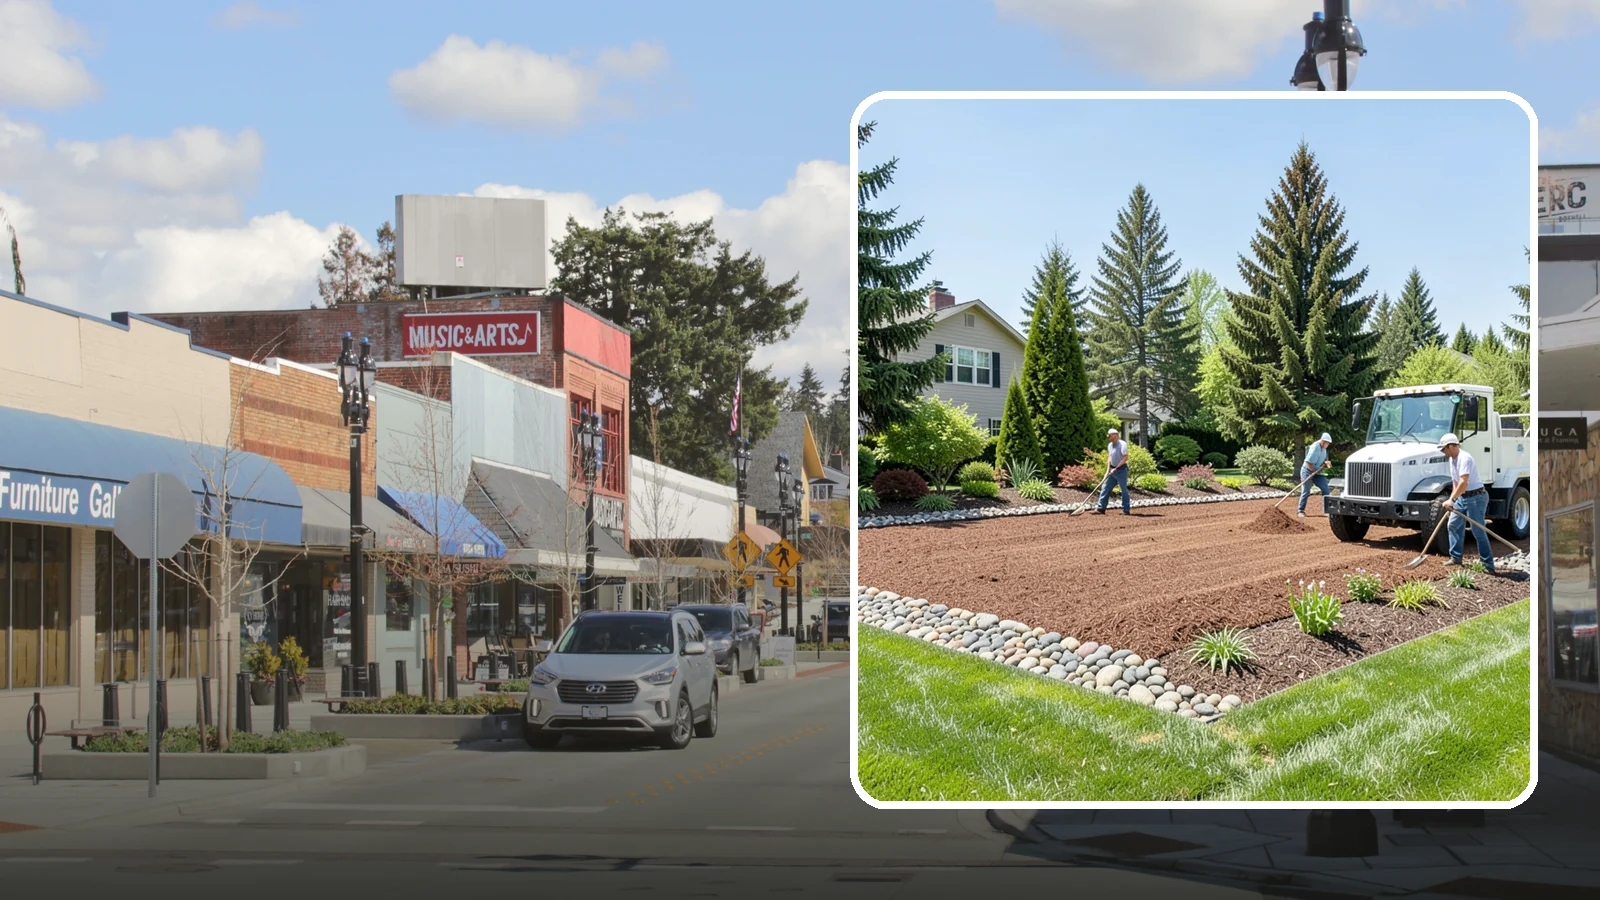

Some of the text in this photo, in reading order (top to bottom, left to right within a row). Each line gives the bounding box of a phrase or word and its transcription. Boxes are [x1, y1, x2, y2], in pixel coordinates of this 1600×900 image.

[409, 323, 509, 349] MUSIC&ARTS
[0, 471, 79, 515] Furniture
[453, 563, 479, 574] SUSHI
